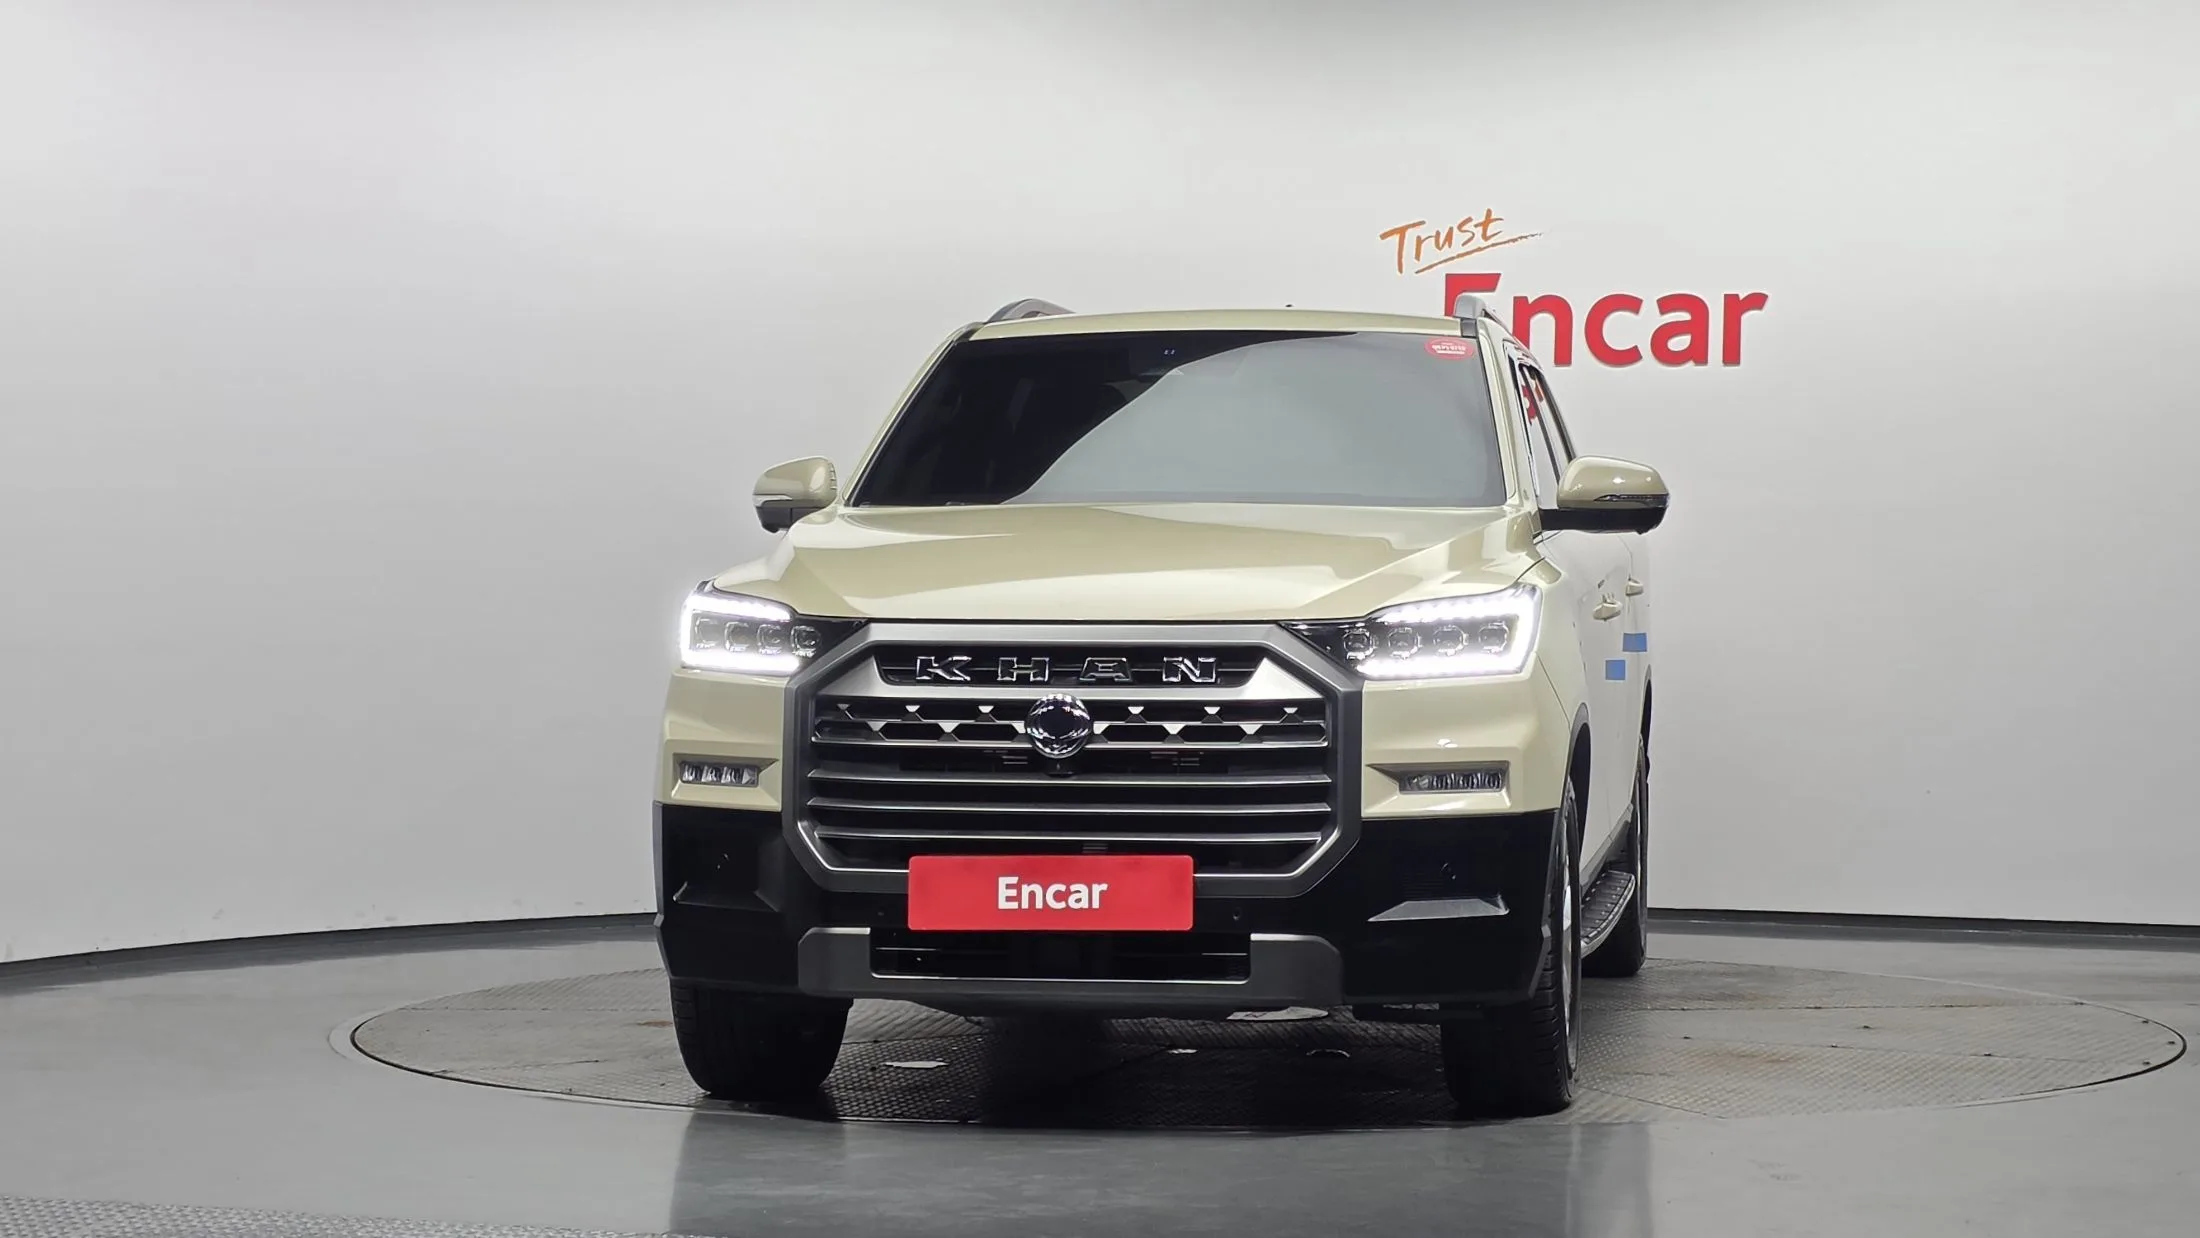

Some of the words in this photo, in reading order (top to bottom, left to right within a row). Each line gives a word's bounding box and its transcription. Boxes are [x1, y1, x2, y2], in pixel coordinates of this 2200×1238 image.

[1379, 208, 1504, 275] Trust
[915, 656, 1219, 683] KHAN
[997, 876, 1108, 910] Encar
